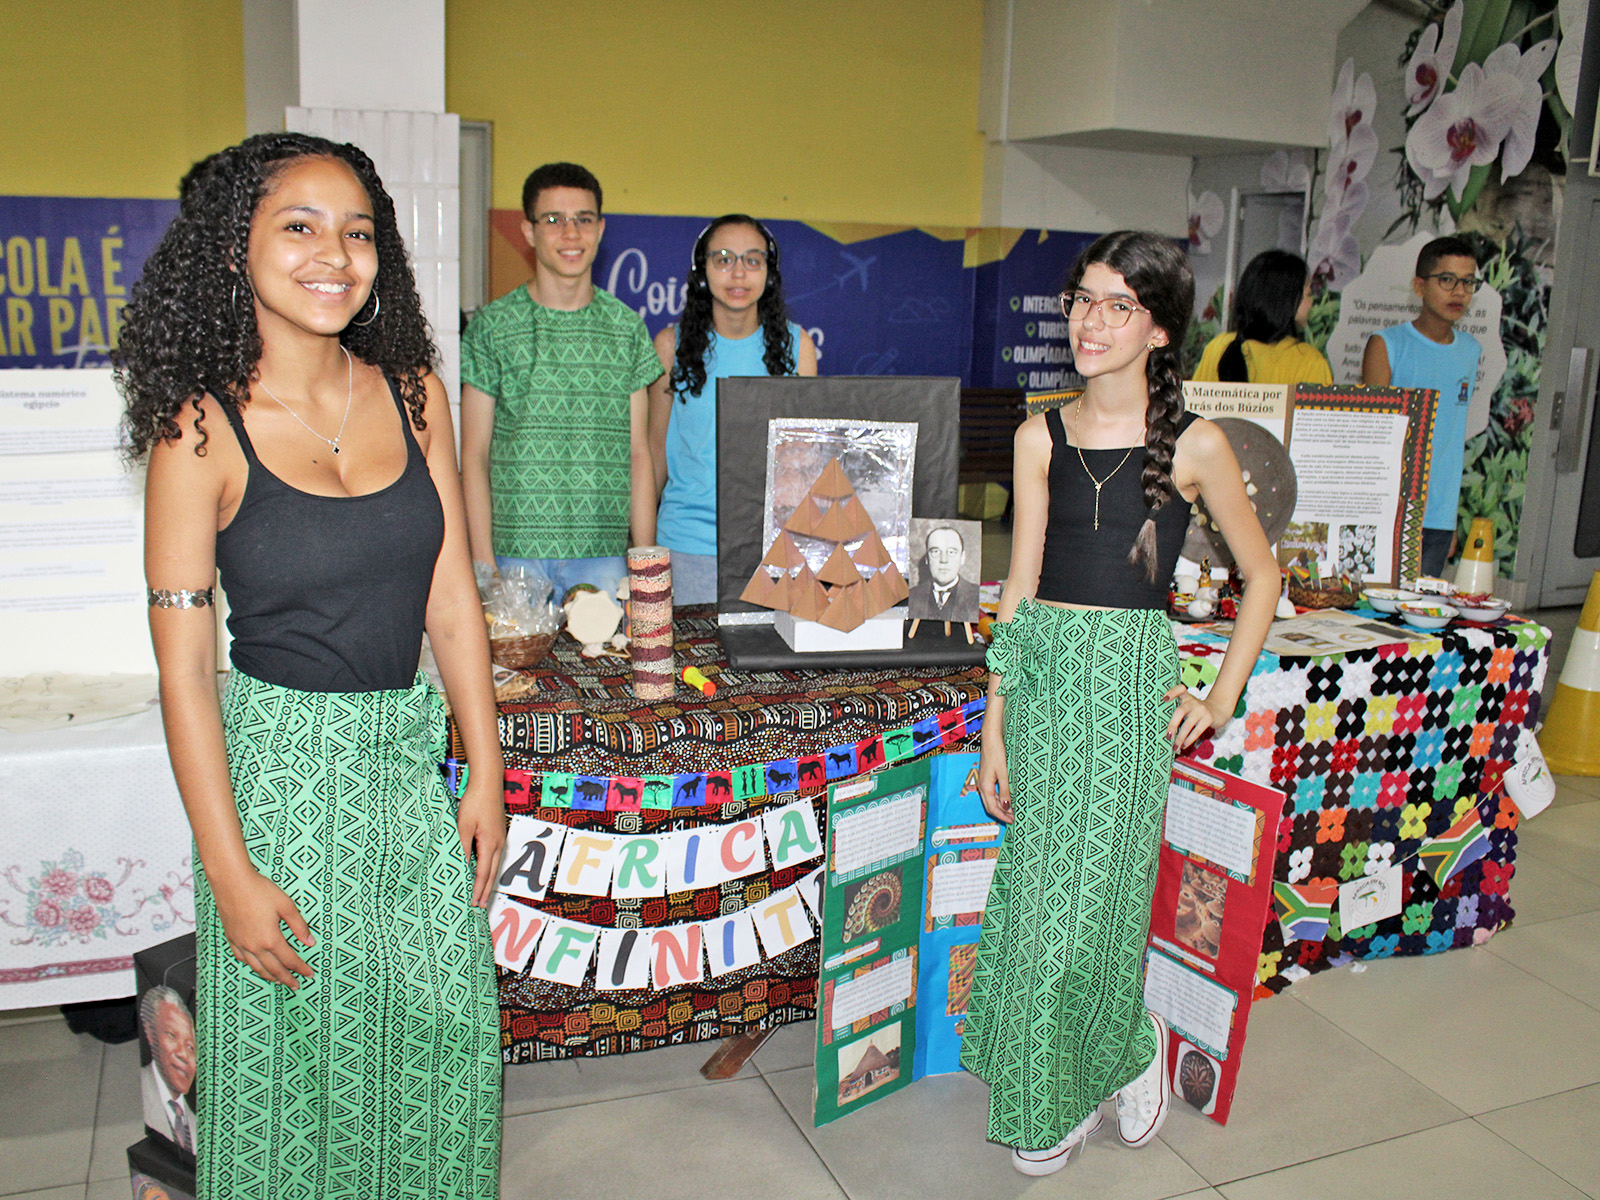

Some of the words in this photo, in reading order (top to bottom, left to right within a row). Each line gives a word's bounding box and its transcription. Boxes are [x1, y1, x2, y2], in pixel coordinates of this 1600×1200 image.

[102, 225, 126, 296] É
[1348, 316, 1381, 326] palavras
[1038, 321, 1070, 339] TURIS
[1470, 325, 1487, 335] que
[1192, 386, 1260, 398] Matemática
[1262, 390, 1282, 402] por
[1189, 401, 1212, 412] trás
[1214, 402, 1235, 413] dos
[1237, 402, 1274, 414] Búzios
[499, 809, 818, 893] ÁFRICA
